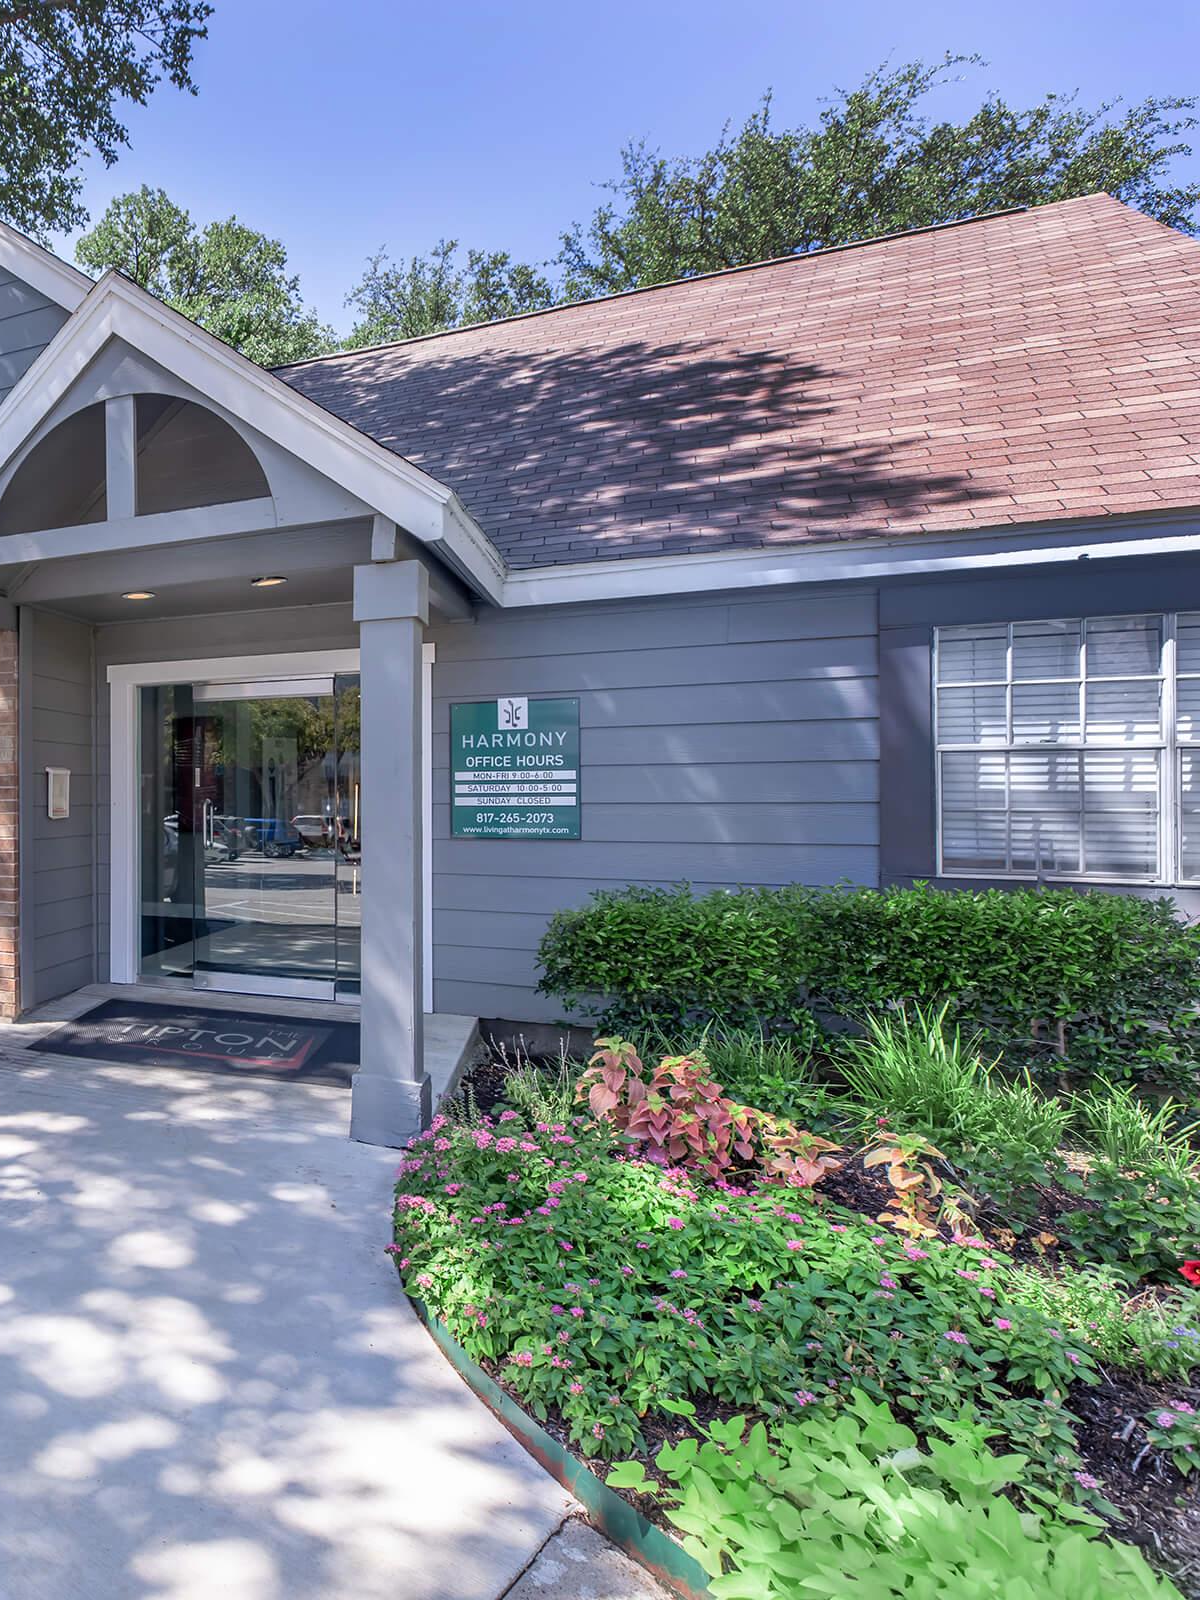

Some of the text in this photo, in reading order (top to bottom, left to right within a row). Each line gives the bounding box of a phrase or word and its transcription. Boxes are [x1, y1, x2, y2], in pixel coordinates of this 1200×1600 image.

[462, 731, 567, 749] HARMONY
[466, 755, 564, 767] OFFICE HOURS
[512, 771, 554, 779] 9:00-6:00
[467, 784, 562, 792] SATURDAY 10:00-5:00
[477, 797, 552, 805] SUNDAY CLOSED
[476, 813, 555, 823] 817-265-2073
[463, 826, 569, 835] www.livingatharmonytx.com
[121, 1022, 298, 1051] TIPTON
